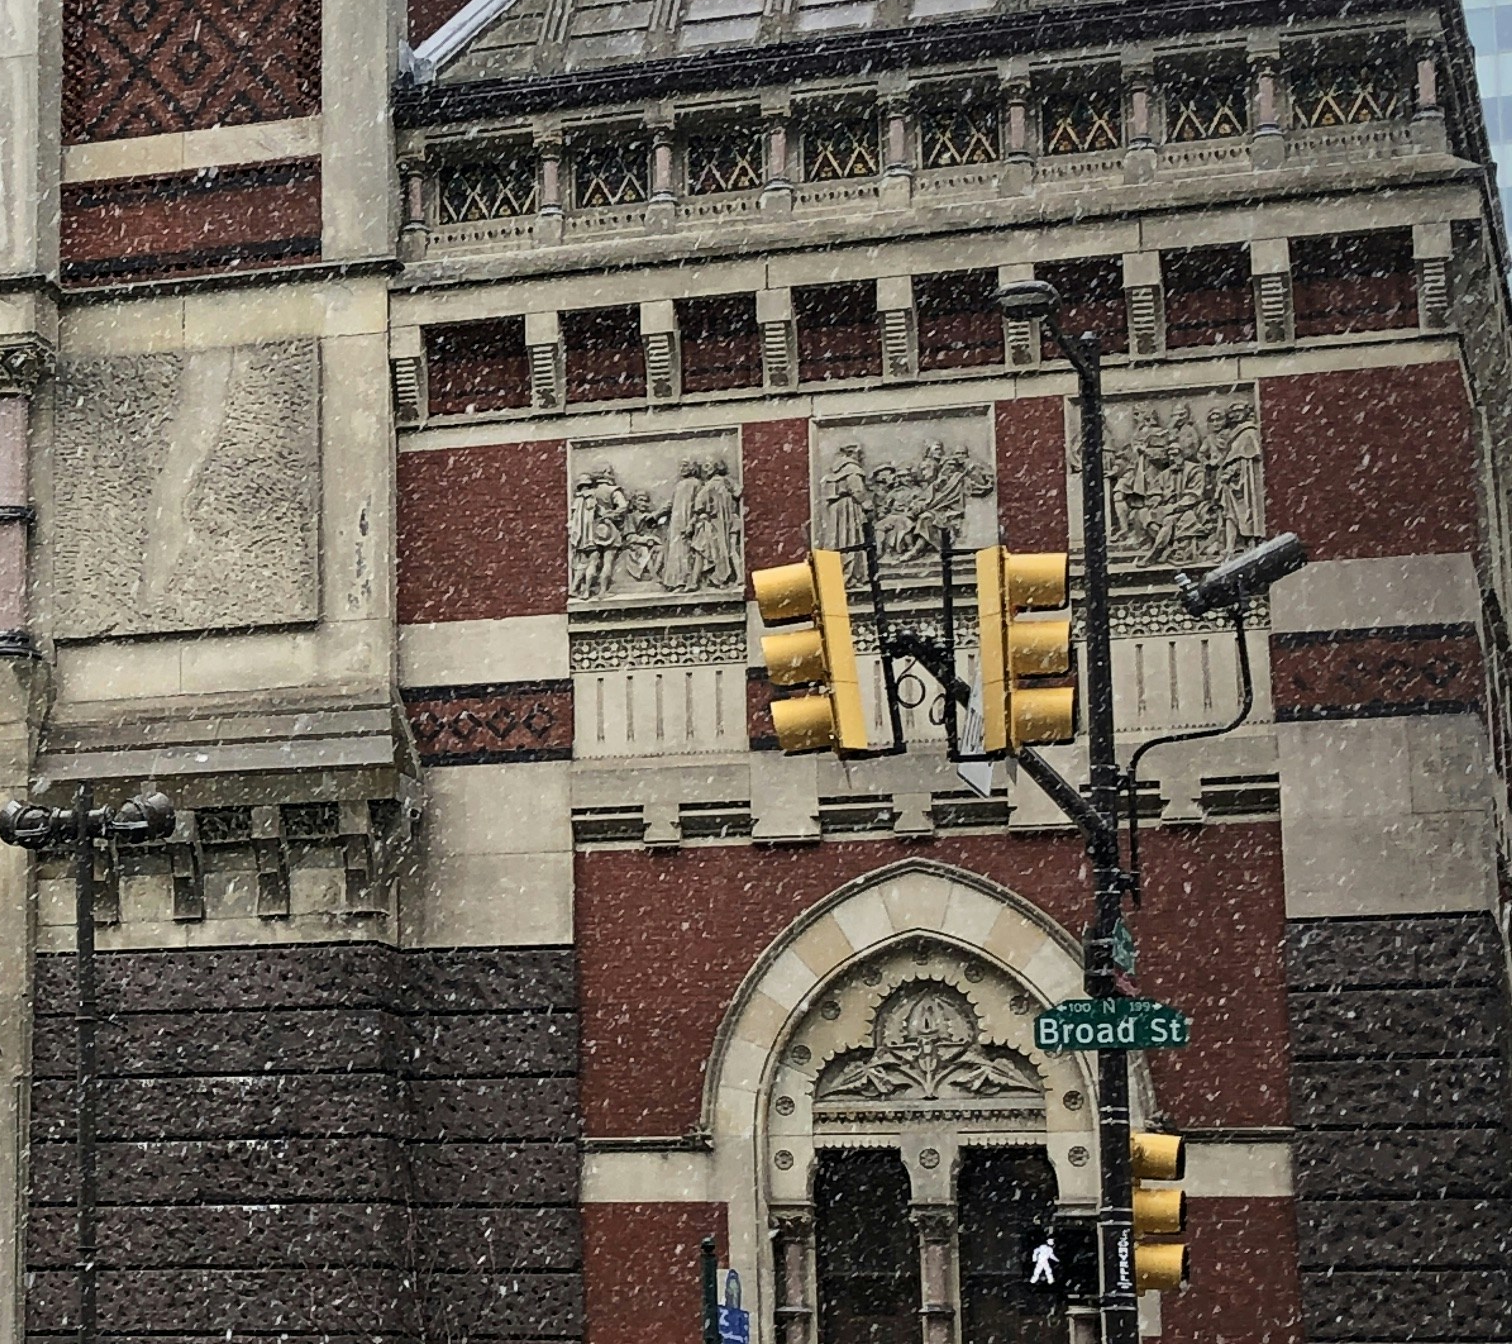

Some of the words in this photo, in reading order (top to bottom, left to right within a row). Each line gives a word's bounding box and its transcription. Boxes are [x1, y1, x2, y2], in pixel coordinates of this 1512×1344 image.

[1068, 1002, 1092, 1014] 100
[1102, 1000, 1117, 1014] N
[1039, 1017, 1135, 1045] Broad
[1150, 1018, 1184, 1044] St
